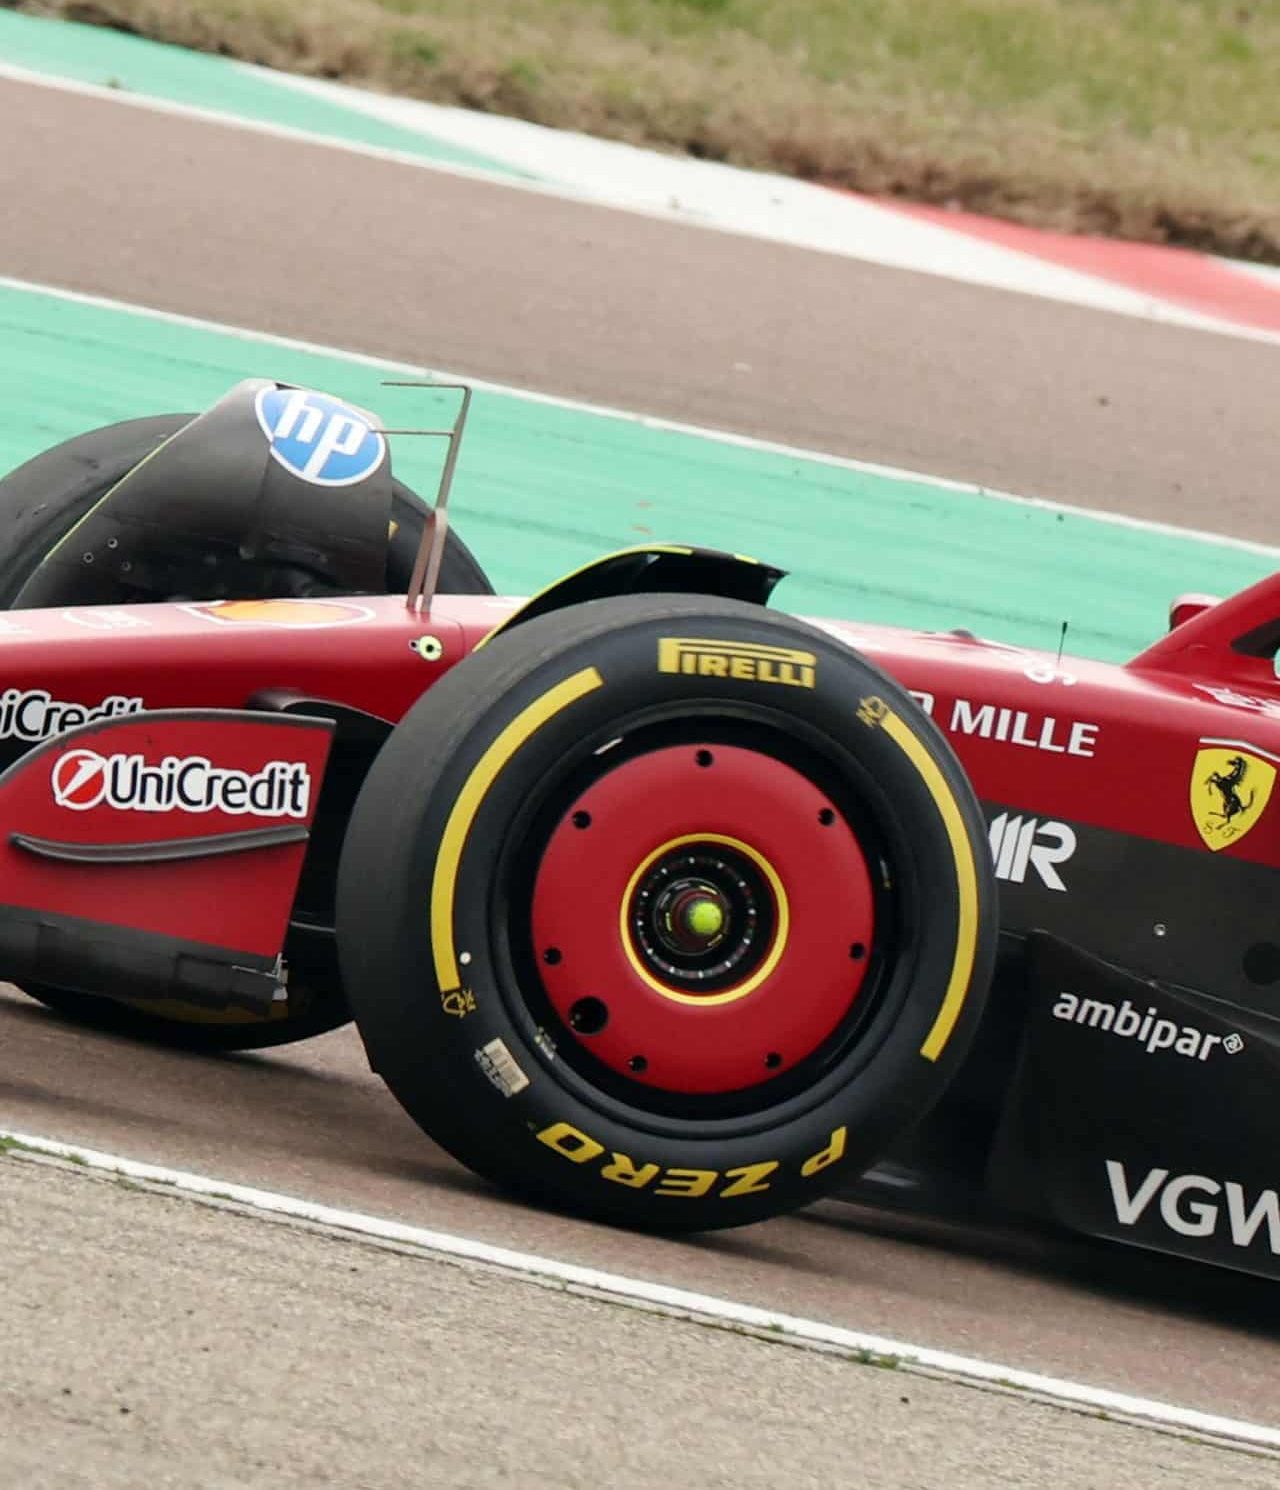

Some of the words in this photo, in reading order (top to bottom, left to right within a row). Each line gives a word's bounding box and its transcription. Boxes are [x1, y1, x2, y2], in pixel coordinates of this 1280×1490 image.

[271, 391, 373, 480] hp
[658, 636, 817, 689] PIRELLI
[949, 699, 1100, 758] MILLE
[108, 757, 308, 814] UniCredit
[1052, 991, 1222, 1062] ambipar
[536, 1121, 780, 1198] ZERO
[800, 1126, 848, 1177] P
